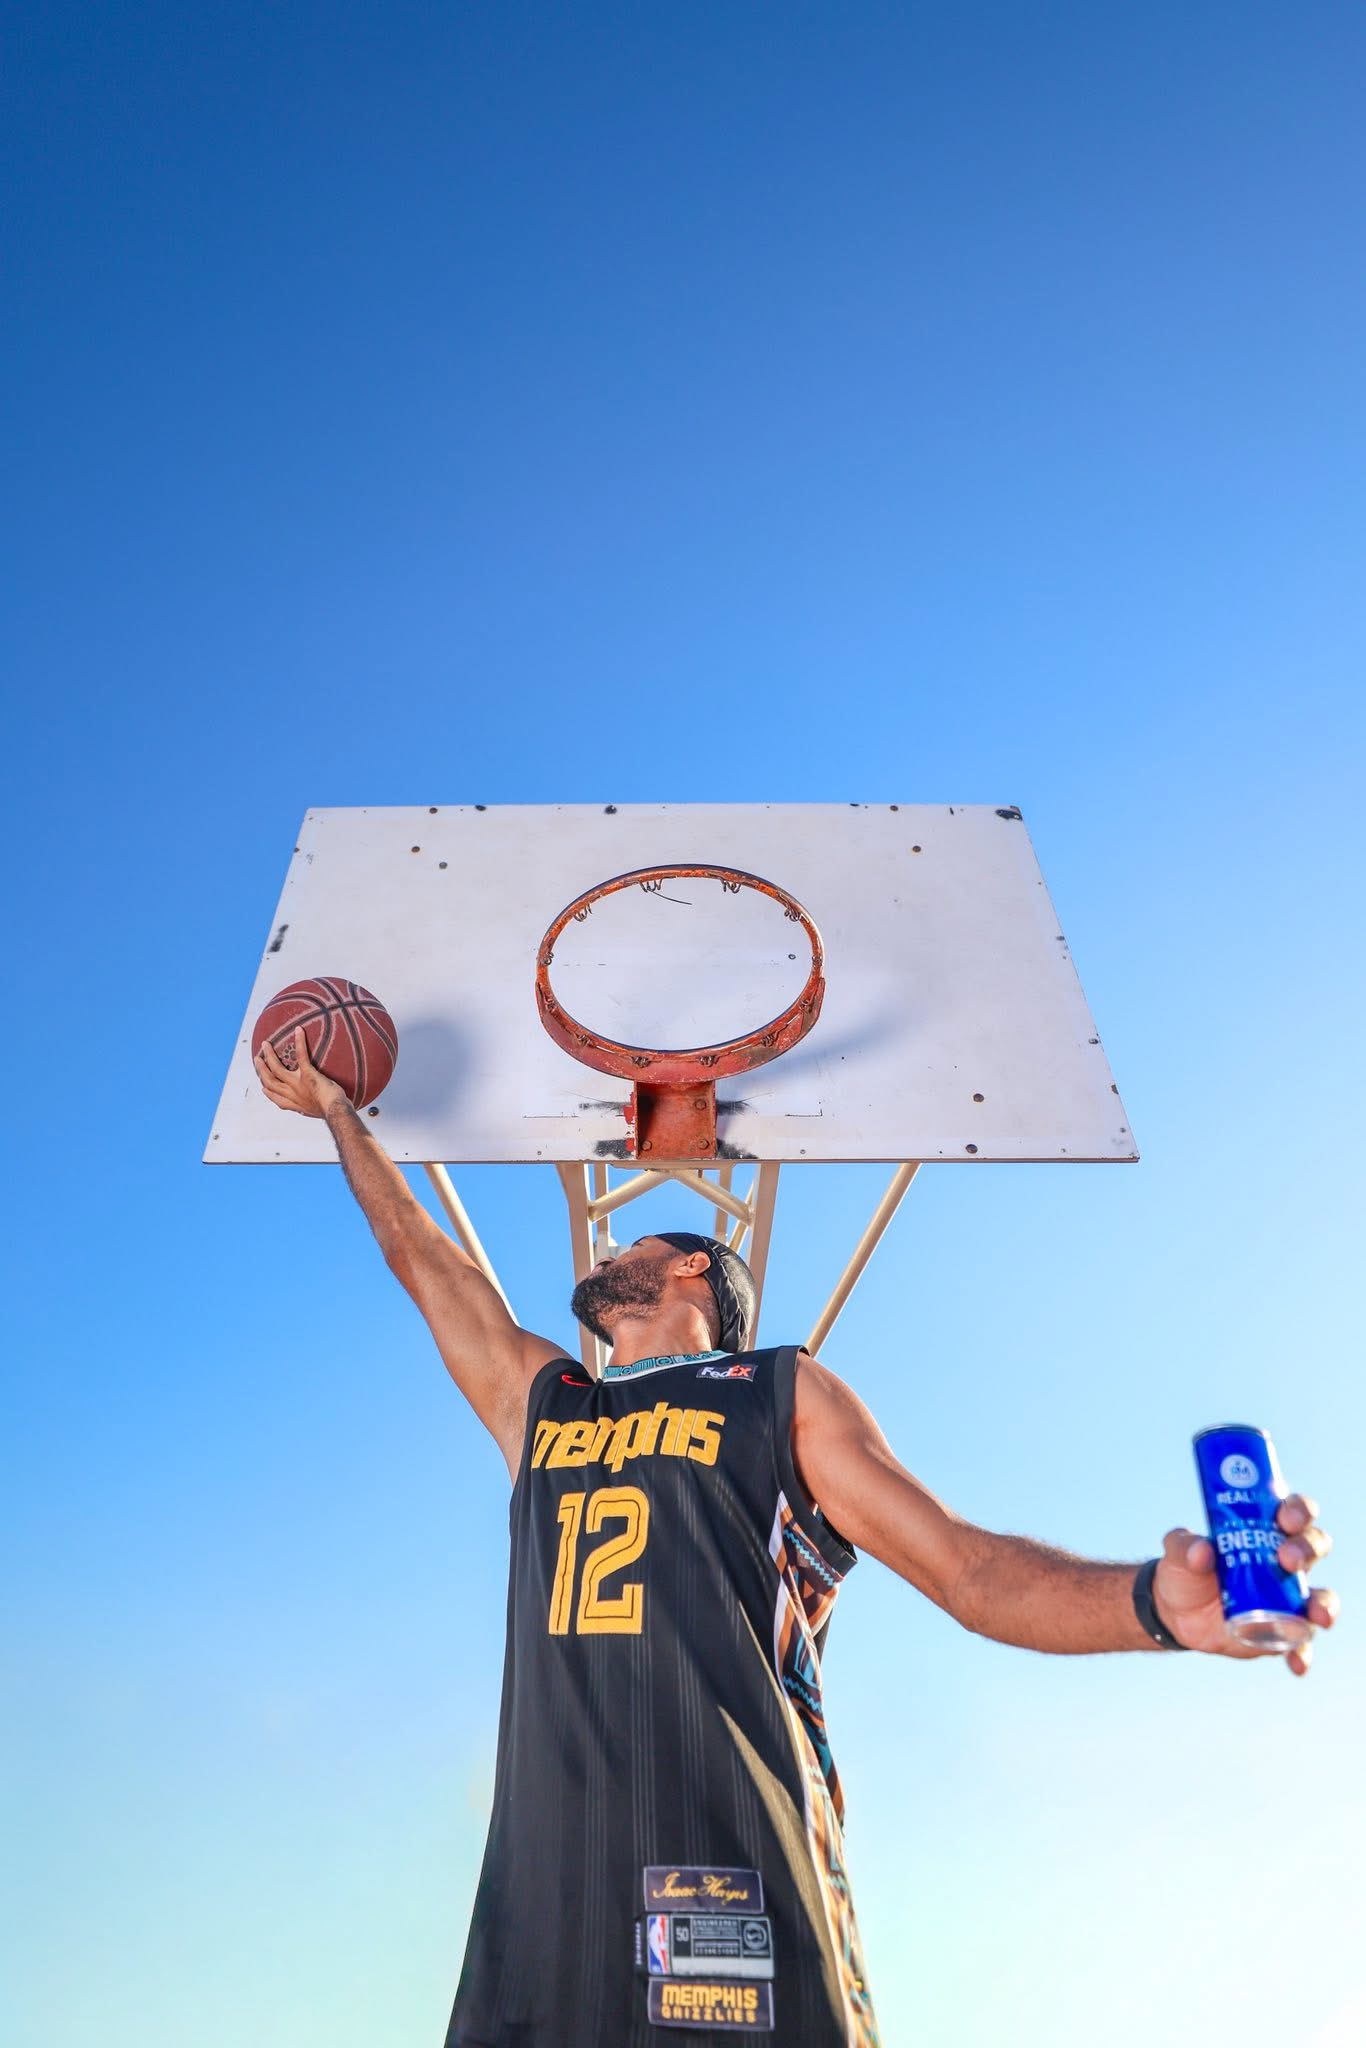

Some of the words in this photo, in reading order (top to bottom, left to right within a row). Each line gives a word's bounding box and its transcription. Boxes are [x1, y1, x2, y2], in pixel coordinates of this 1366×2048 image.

[700, 1364, 752, 1378] FedEx
[1216, 1529, 1284, 1555] ENERG
[548, 1485, 650, 1636] 12
[1224, 1551, 1279, 1569] DRIN
[675, 1926, 690, 1942] 50
[661, 1983, 758, 2011] MEMPHIS
[660, 2004, 757, 2024] GRIZZLIES
